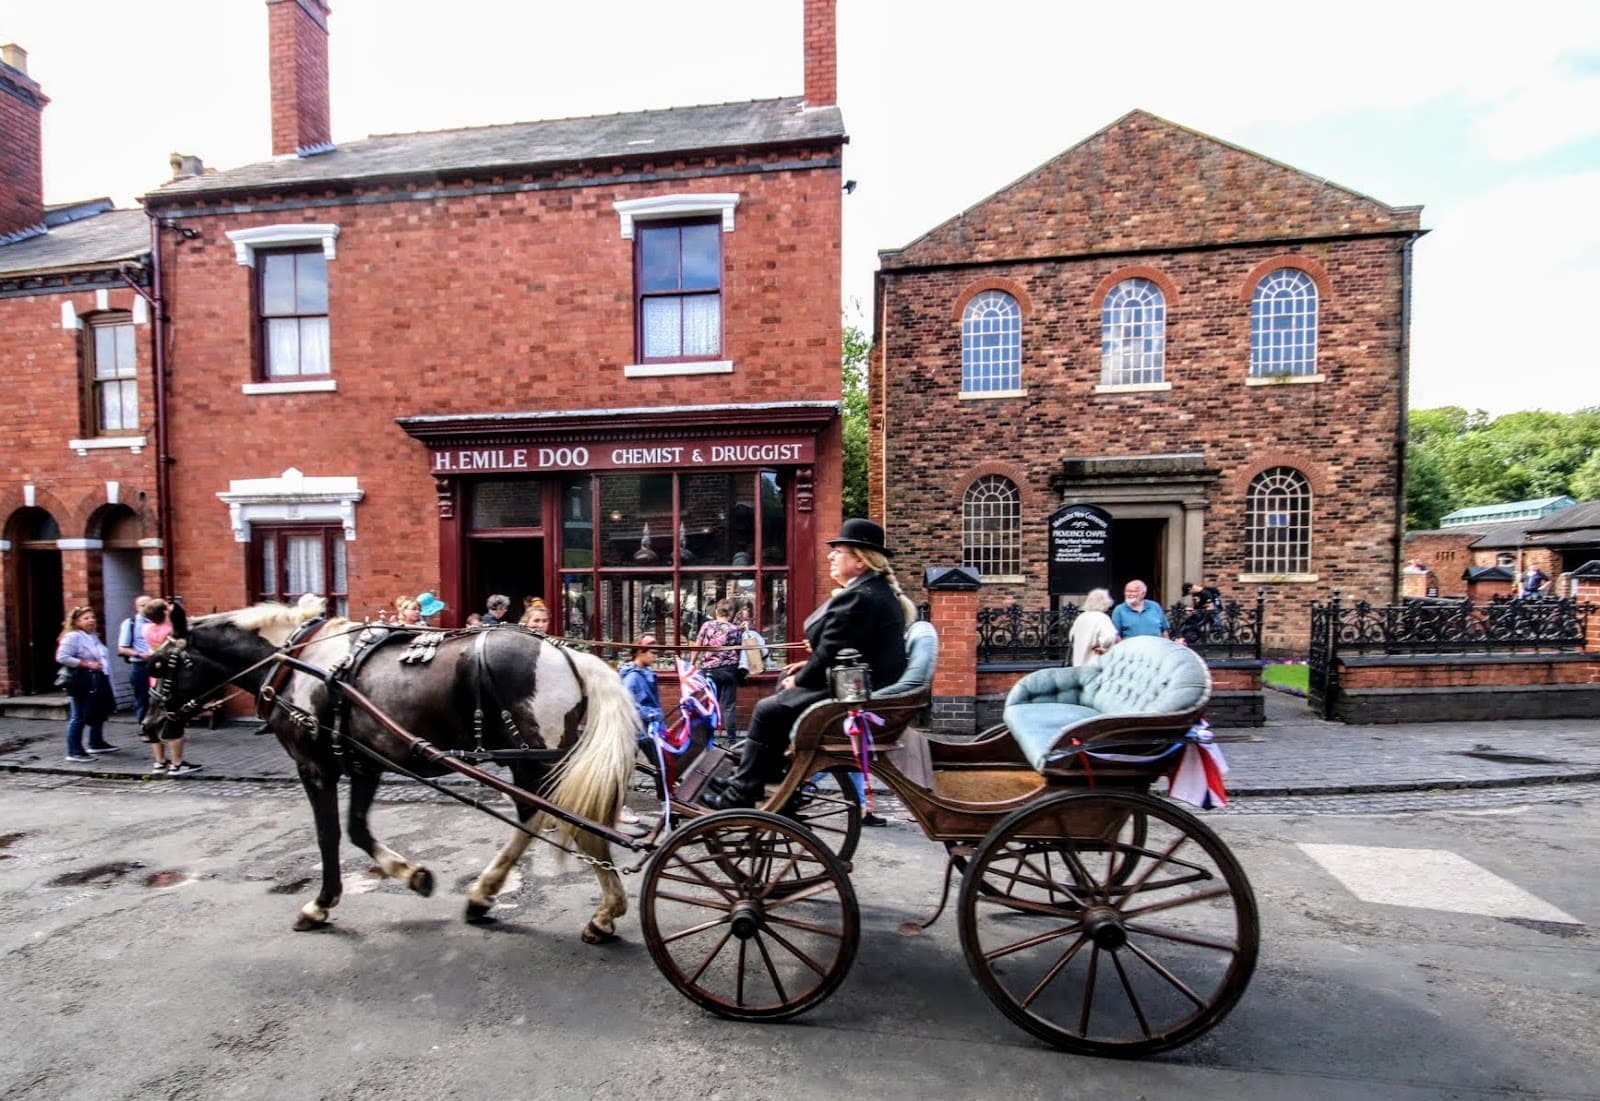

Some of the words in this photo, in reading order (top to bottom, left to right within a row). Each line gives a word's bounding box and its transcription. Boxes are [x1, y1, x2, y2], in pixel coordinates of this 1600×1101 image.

[538, 447, 589, 467] DOO
[611, 447, 684, 464] CHEMIST
[691, 448, 704, 463] &
[711, 443, 802, 462] DRUGGIST
